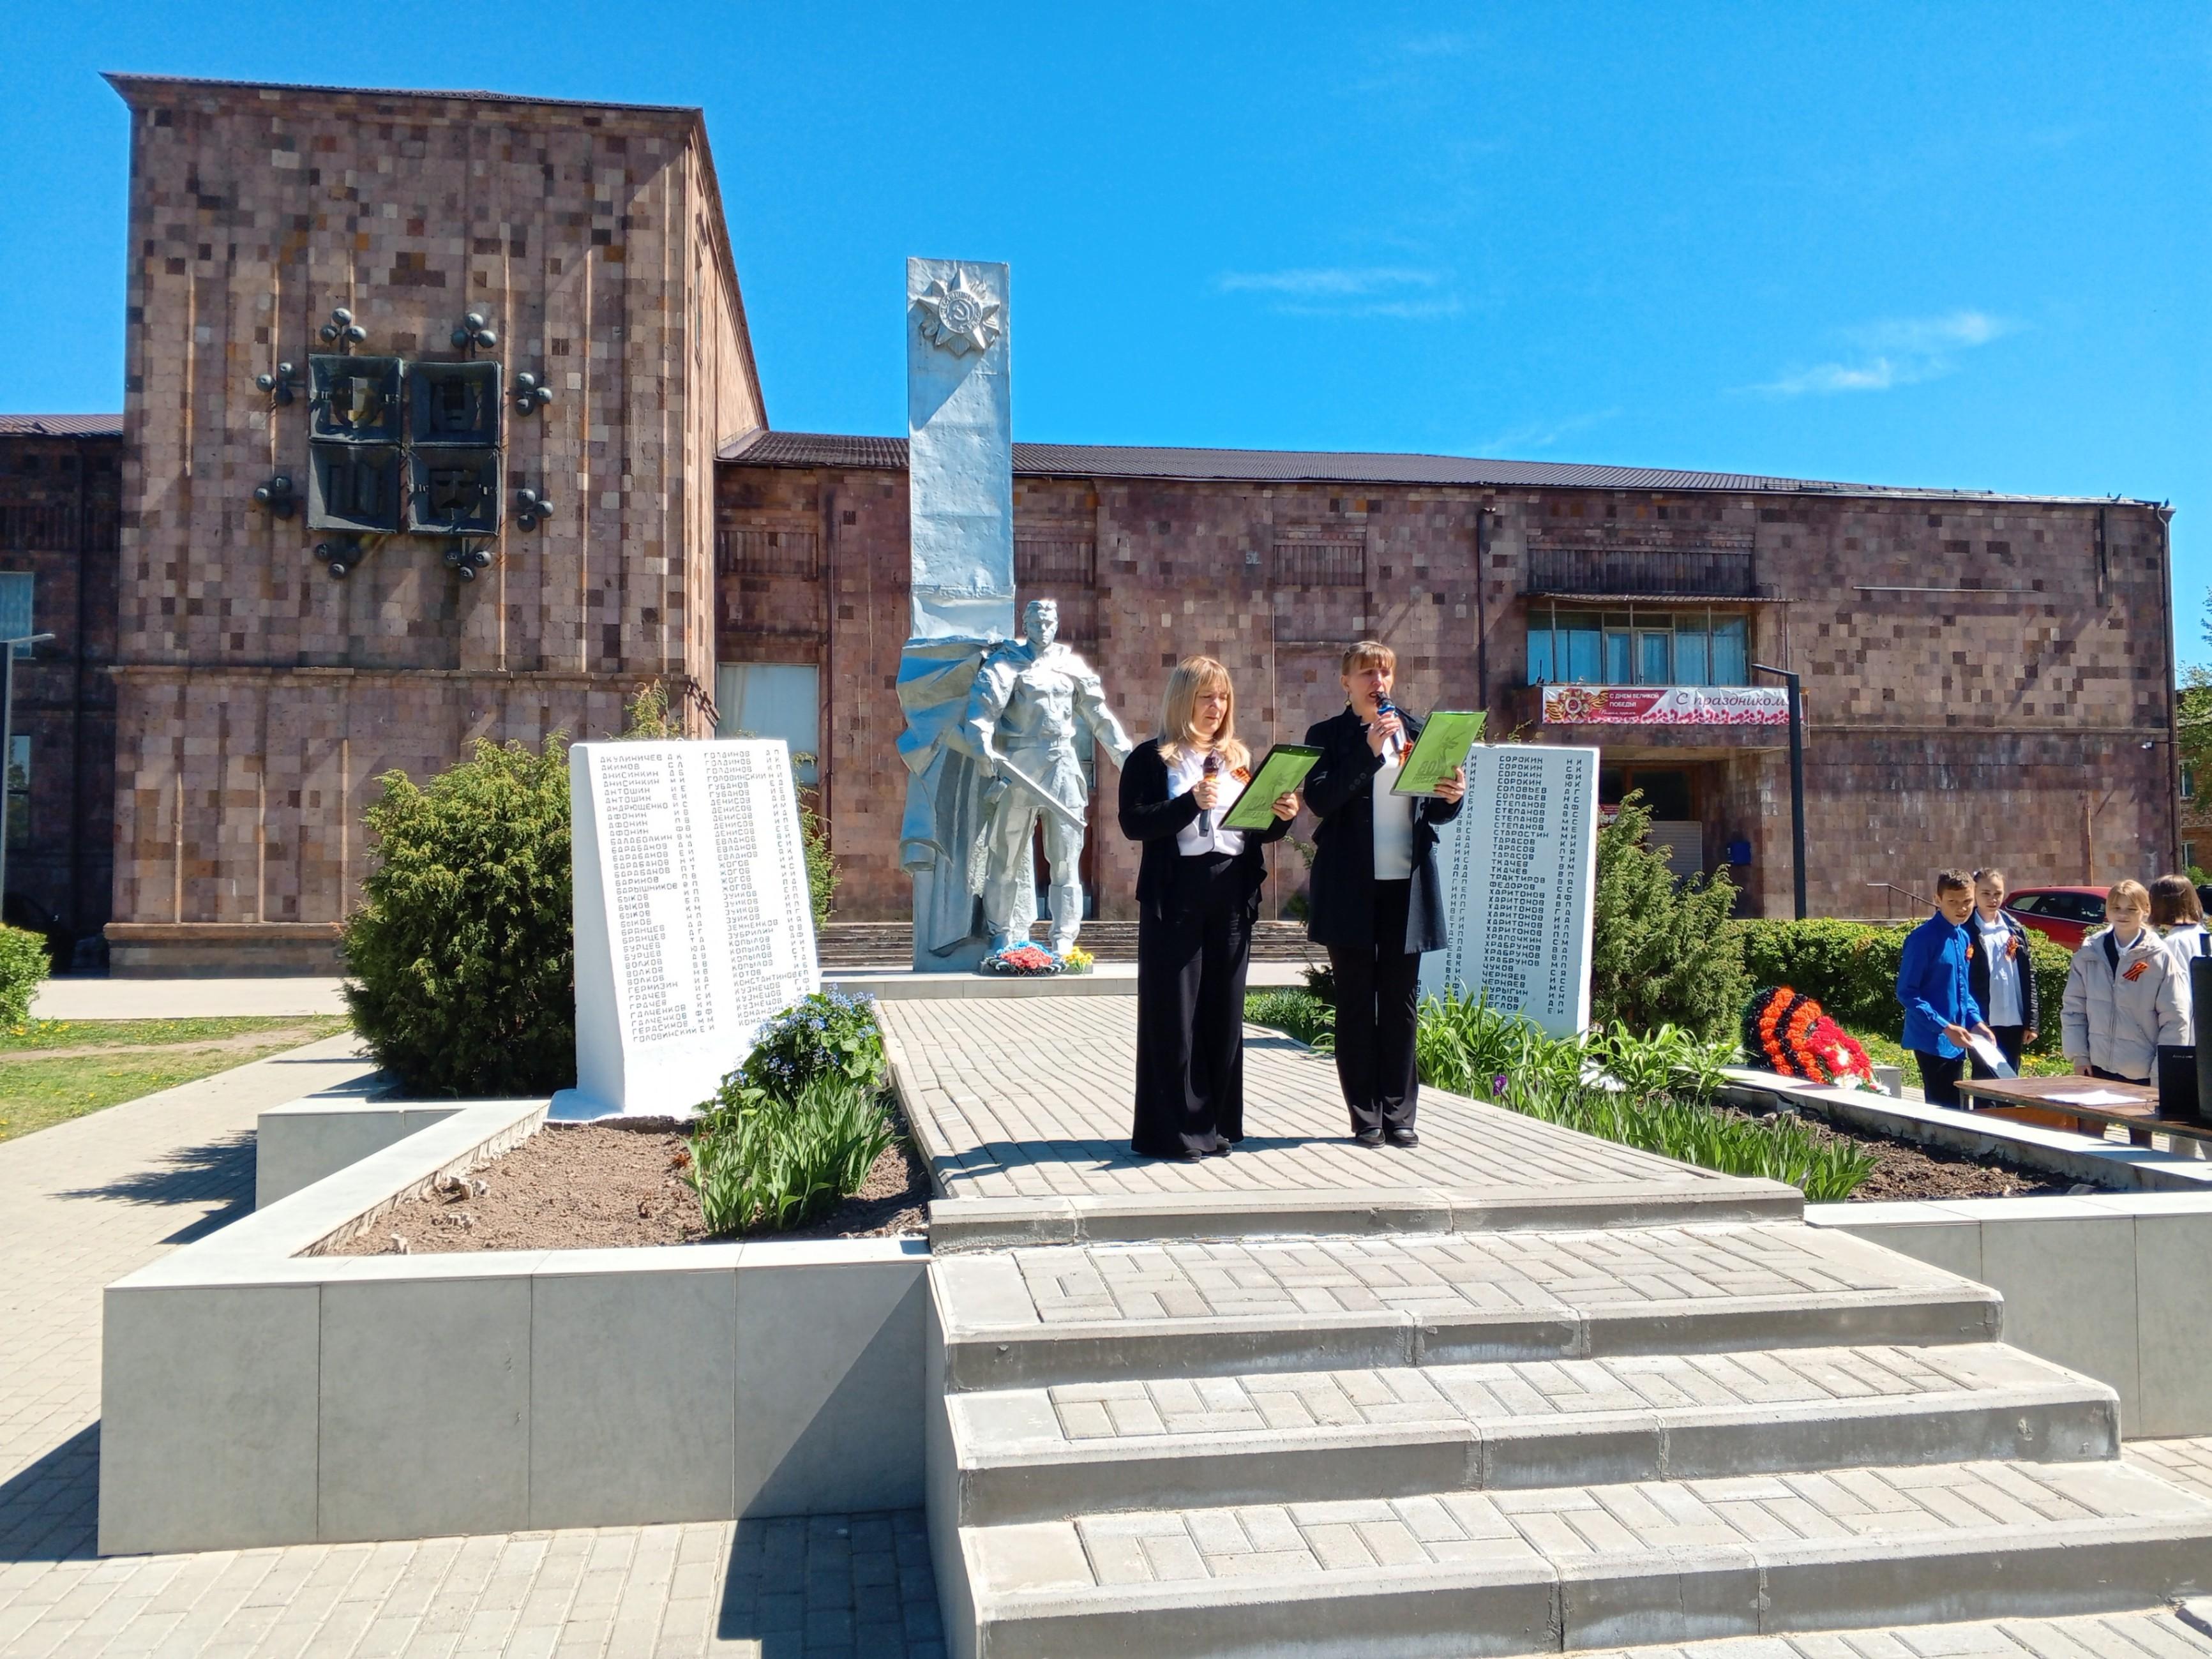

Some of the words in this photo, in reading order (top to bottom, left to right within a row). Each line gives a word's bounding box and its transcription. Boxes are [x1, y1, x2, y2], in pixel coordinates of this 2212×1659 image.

[1676, 693, 1689, 705] С
[1500, 756, 1542, 764] СОРОКИН
[1499, 763, 1542, 771] СОРОКИН
[1498, 777, 1541, 786] СОРОКИН
[1497, 785, 1547, 794] СОЛОВЬЕВ
[1496, 792, 1546, 801] СОЛОВЬЕВ
[1496, 800, 1546, 809] СТЕПАНОВ
[1495, 807, 1545, 816] СТЕПАНОВ
[1494, 814, 1544, 823] СТЕПАНОВ
[1494, 822, 1544, 830] СТЕПАНОВ
[1493, 829, 1549, 837] СТАРОСТИН
[1493, 837, 1535, 845] ТАРАСОВ
[1493, 844, 1535, 853] ТАРАСОВ
[1492, 852, 1534, 860] ТАРАСОВ
[1491, 859, 1528, 867] ТКАЧЕВ
[1491, 866, 1527, 875] ТКАЧЕВ
[1489, 874, 1545, 883] ТРАКТИРОВ
[1489, 882, 1535, 890] ФЕДОРОВ
[1489, 889, 1545, 899] ХАРИТОНОВ
[1489, 896, 1544, 906] ХАРИТОНОВ
[1489, 903, 1544, 913] ХАРИТОНОВ
[1487, 911, 1543, 921] ХАРИТОНОВ
[1487, 919, 1542, 929] ХАРИТОНОВ
[1487, 926, 1542, 936] ХАРИТОНОВ
[1485, 941, 1540, 951] ХРАБРУНОВ
[1484, 947, 1540, 959] ХРАБРУНОВ
[1484, 956, 1539, 966] ХРАБРУНОВ
[1483, 963, 1514, 972] ЧУКОВ
[1482, 970, 1526, 980] ЧЕРНЯЕВ
[1482, 978, 1525, 988] ЧЕРНЯЕВ
